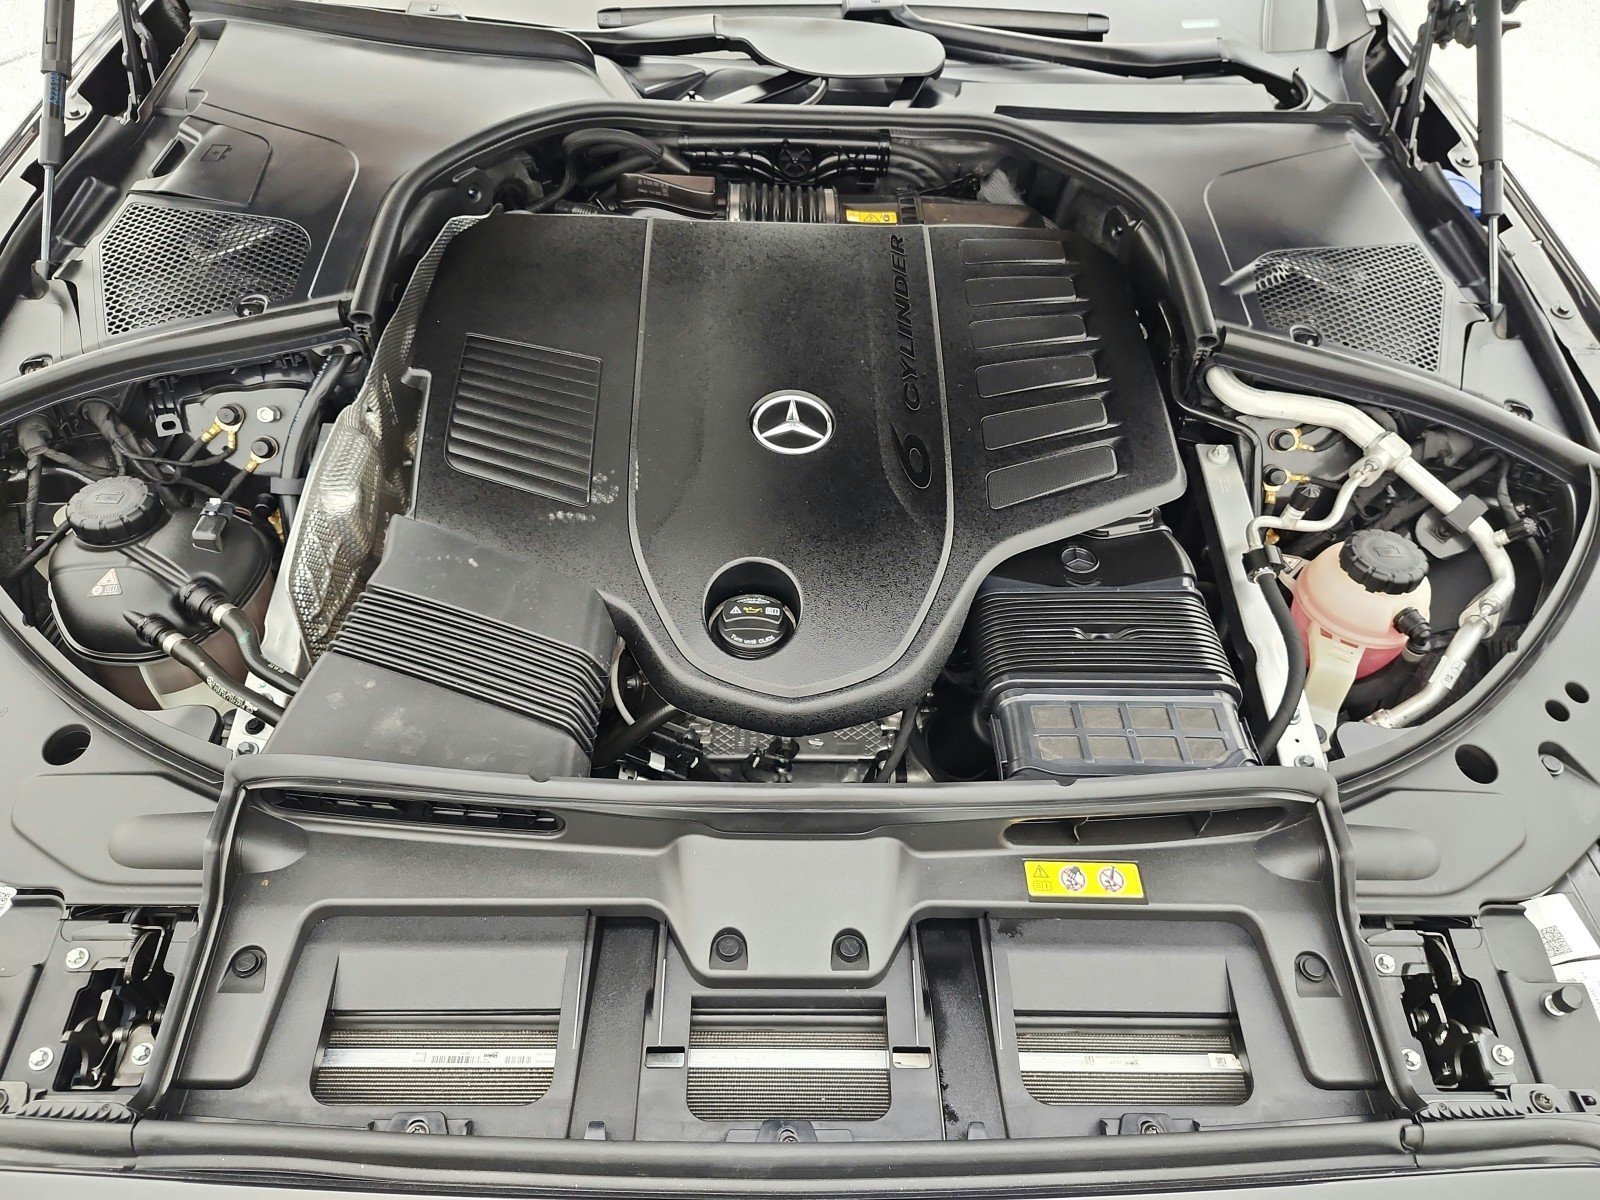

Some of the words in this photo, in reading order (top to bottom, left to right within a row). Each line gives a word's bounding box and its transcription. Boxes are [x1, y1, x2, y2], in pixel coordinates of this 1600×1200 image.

[890, 234, 921, 411] CYLINDER
[890, 423, 933, 490] 6
[730, 633, 743, 642] Turn
[758, 634, 776, 644] CLICK
